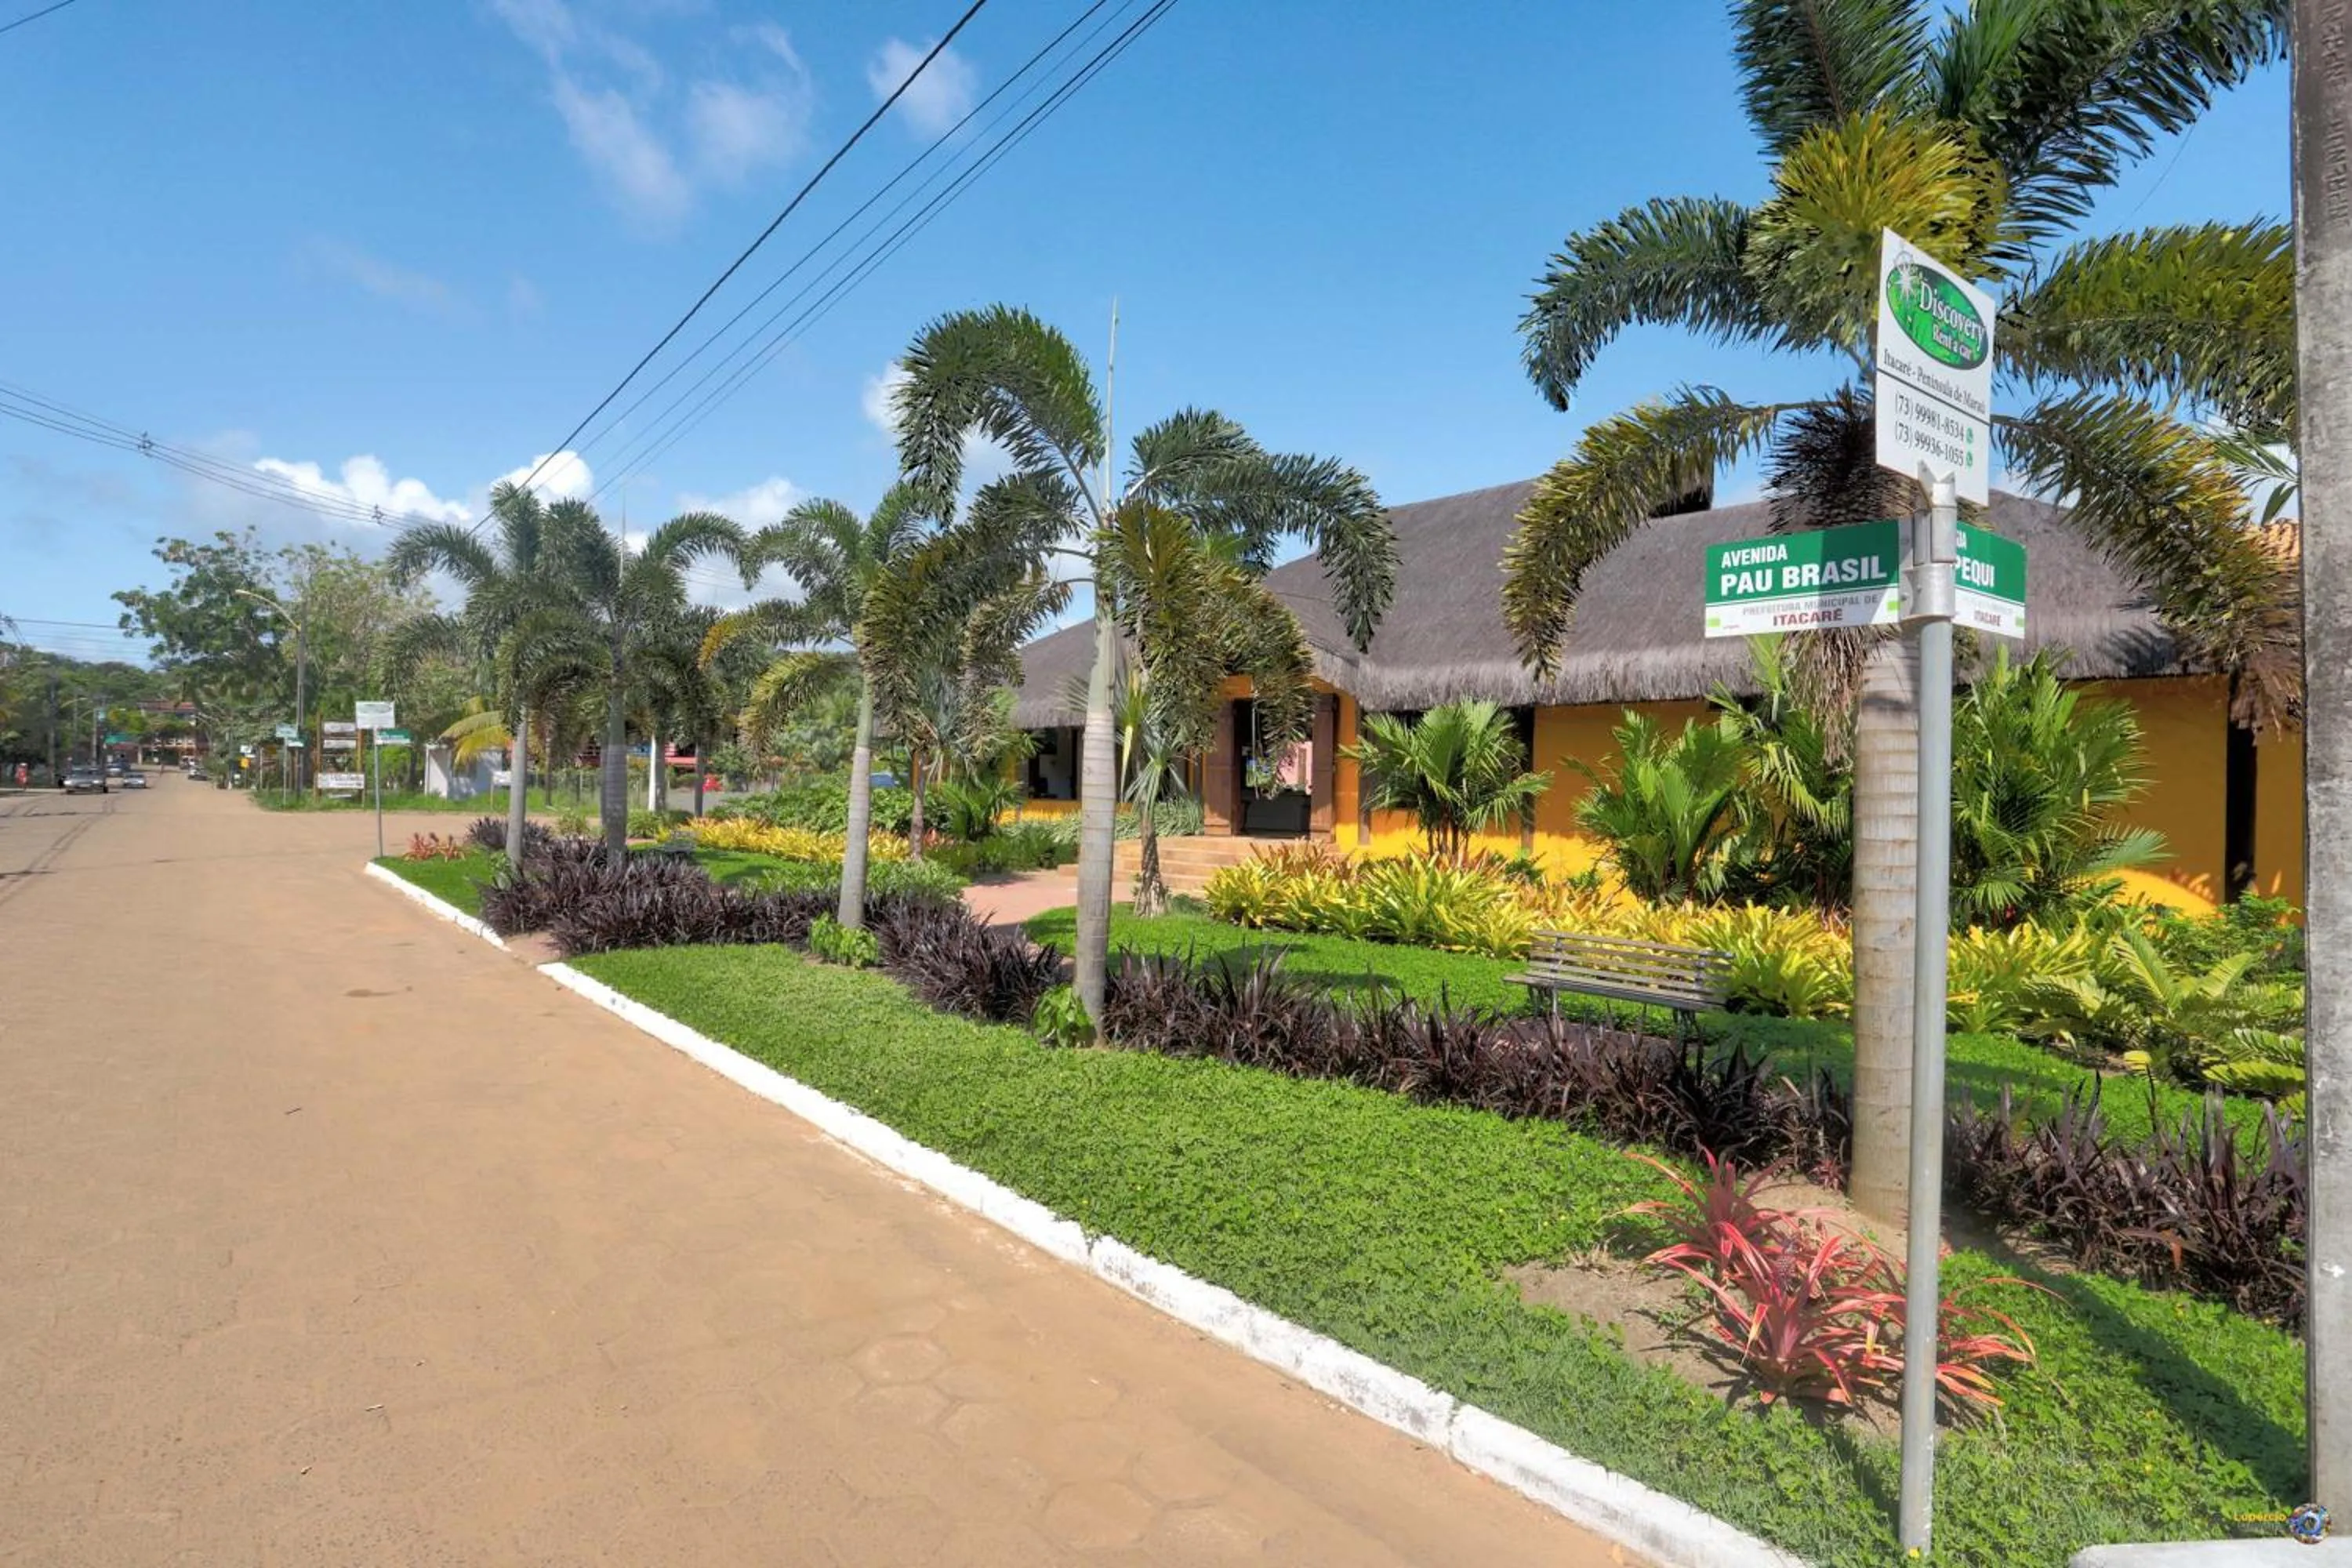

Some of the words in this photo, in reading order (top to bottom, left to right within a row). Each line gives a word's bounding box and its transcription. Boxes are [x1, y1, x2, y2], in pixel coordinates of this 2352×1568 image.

[1919, 281, 1986, 352] Discovery
[1933, 324, 1951, 350] Rent
[1884, 348, 1911, 376] Itacaré
[1954, 384, 1962, 404] de
[1896, 394, 1913, 420] (73)
[1915, 402, 1964, 441] 99981-8534
[1896, 420, 1913, 449] (73)
[1914, 430, 1964, 466] 99936-1055
[1721, 543, 1788, 569] AVENIDA
[1721, 568, 1773, 597] PAU
[1782, 555, 1888, 590] BRASIL
[1743, 602, 1802, 615] PREFEITURA
[1804, 595, 1860, 611] MUNICIPAL
[1864, 594, 1878, 604] DE
[1773, 608, 1844, 626] ITACARÉ
